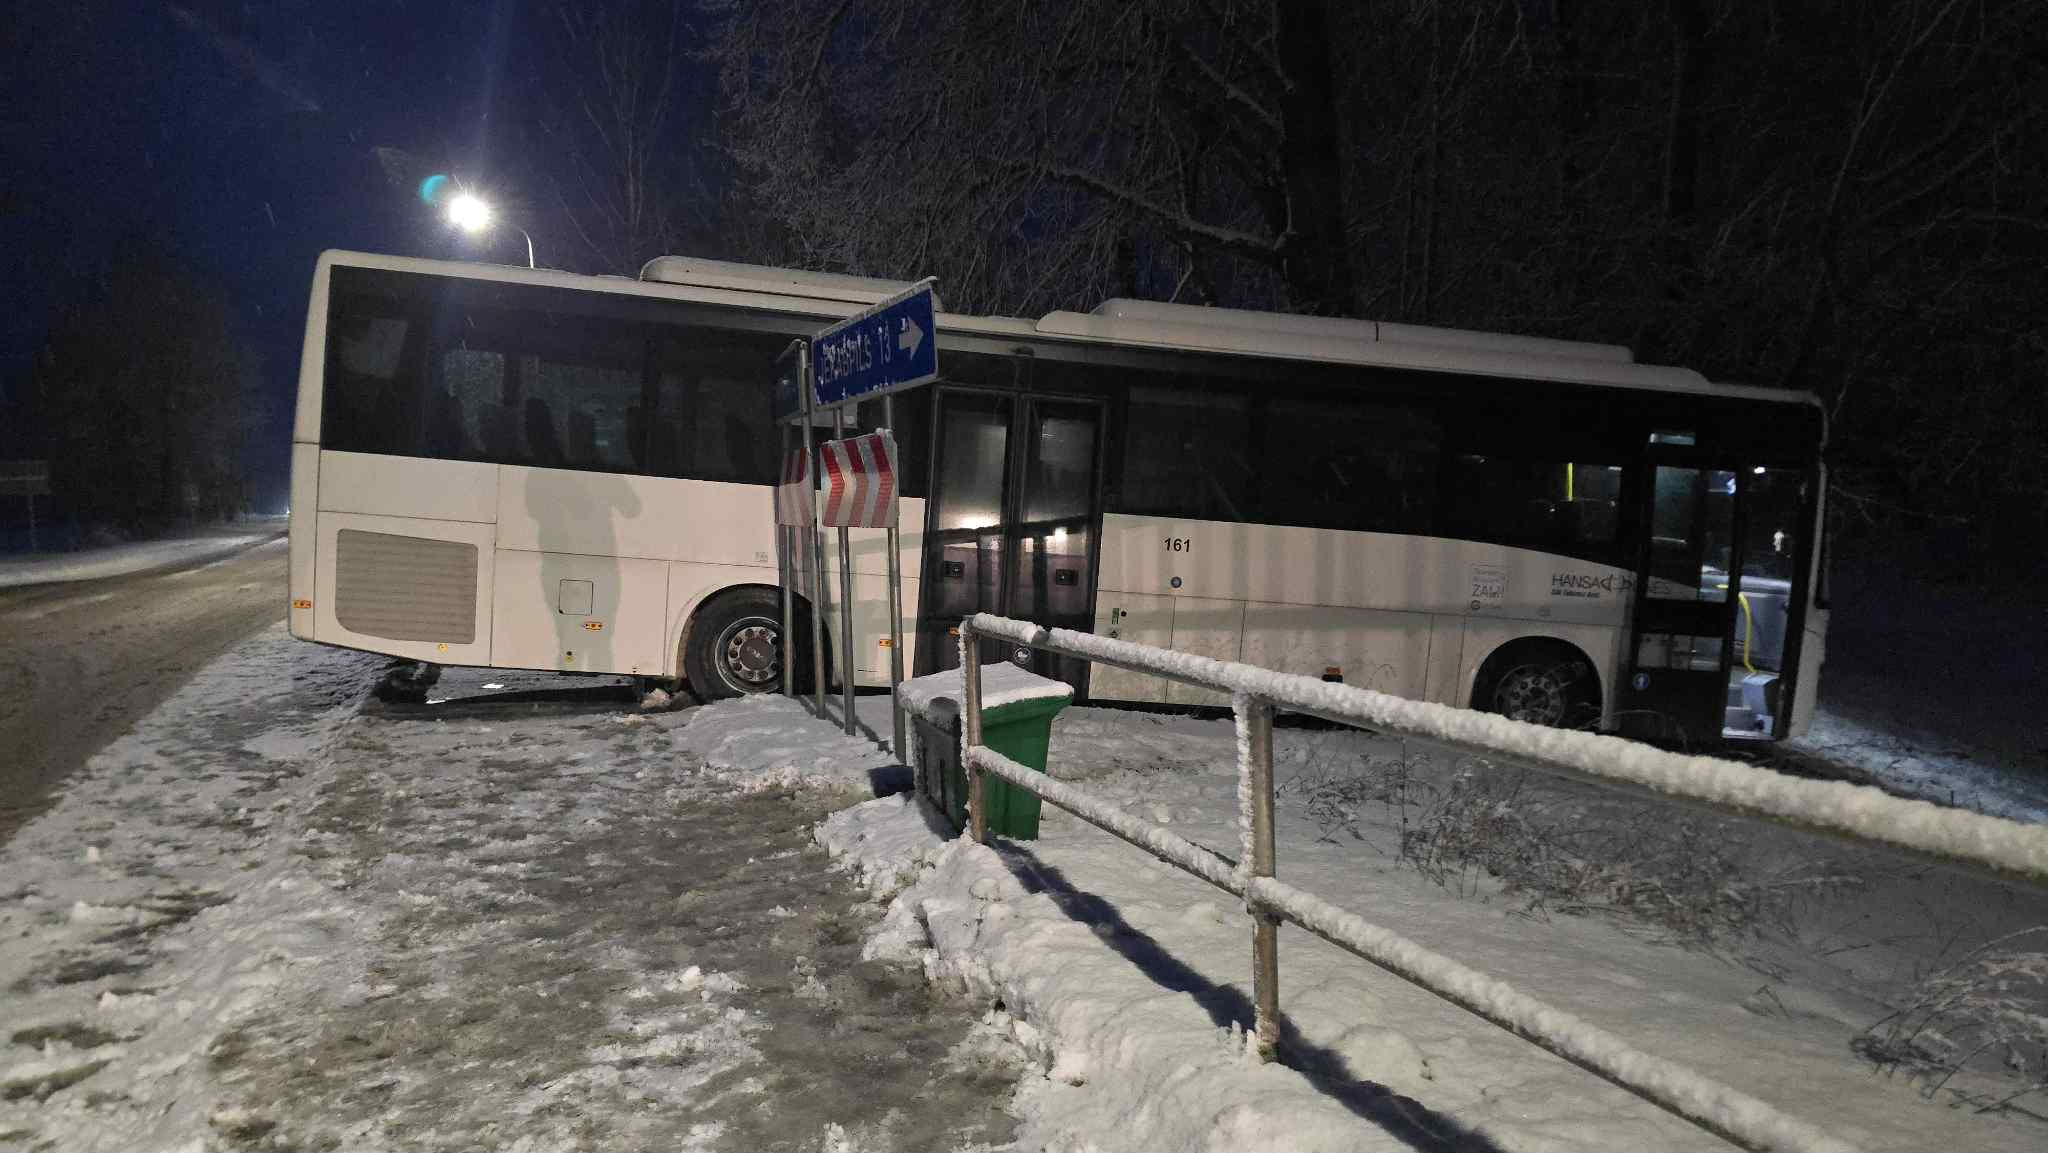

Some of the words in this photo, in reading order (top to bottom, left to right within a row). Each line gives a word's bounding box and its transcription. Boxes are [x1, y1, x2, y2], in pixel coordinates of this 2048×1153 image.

[878, 325, 892, 366] 13
[1164, 537, 1190, 553] 161
[1551, 573, 1600, 590] HANSA
